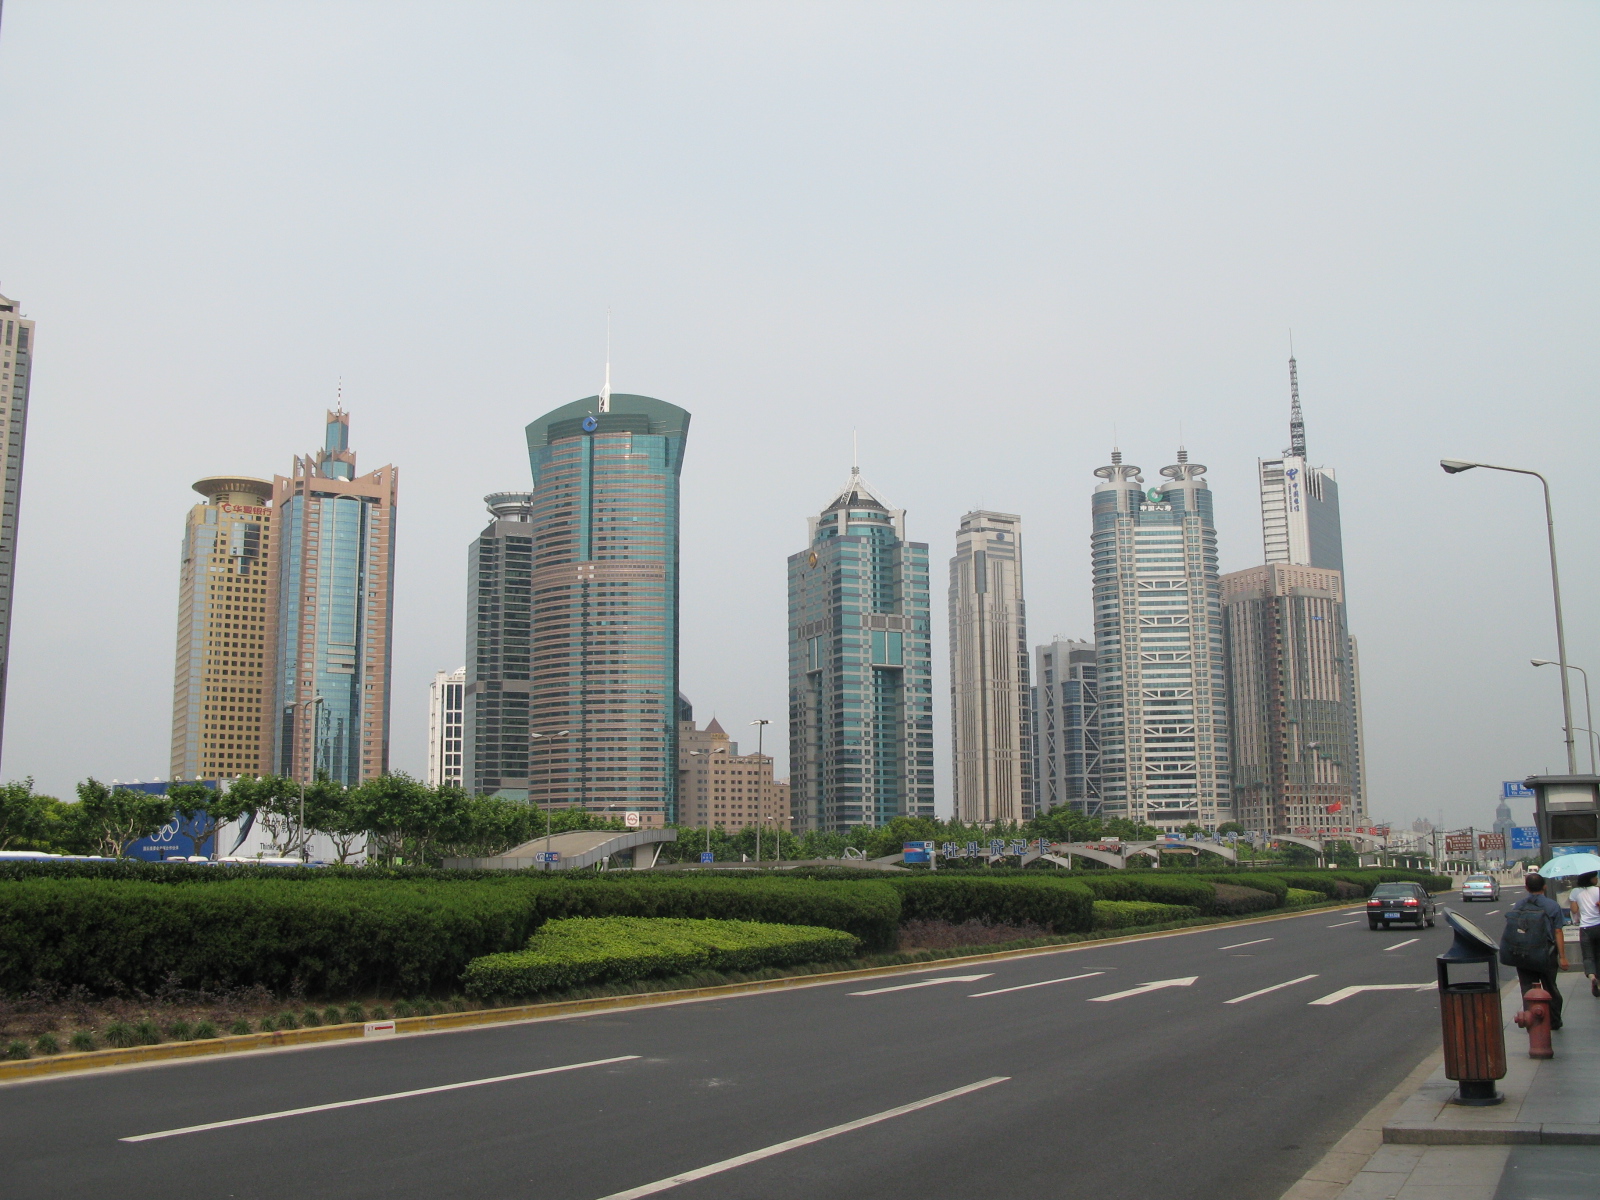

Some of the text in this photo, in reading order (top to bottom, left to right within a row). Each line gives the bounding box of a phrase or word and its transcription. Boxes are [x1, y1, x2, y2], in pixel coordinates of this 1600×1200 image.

[233, 504, 272, 516] 华夏银行
[1140, 504, 1172, 512] 中国人寿
[943, 838, 1051, 860] 牡丹贷记卡
